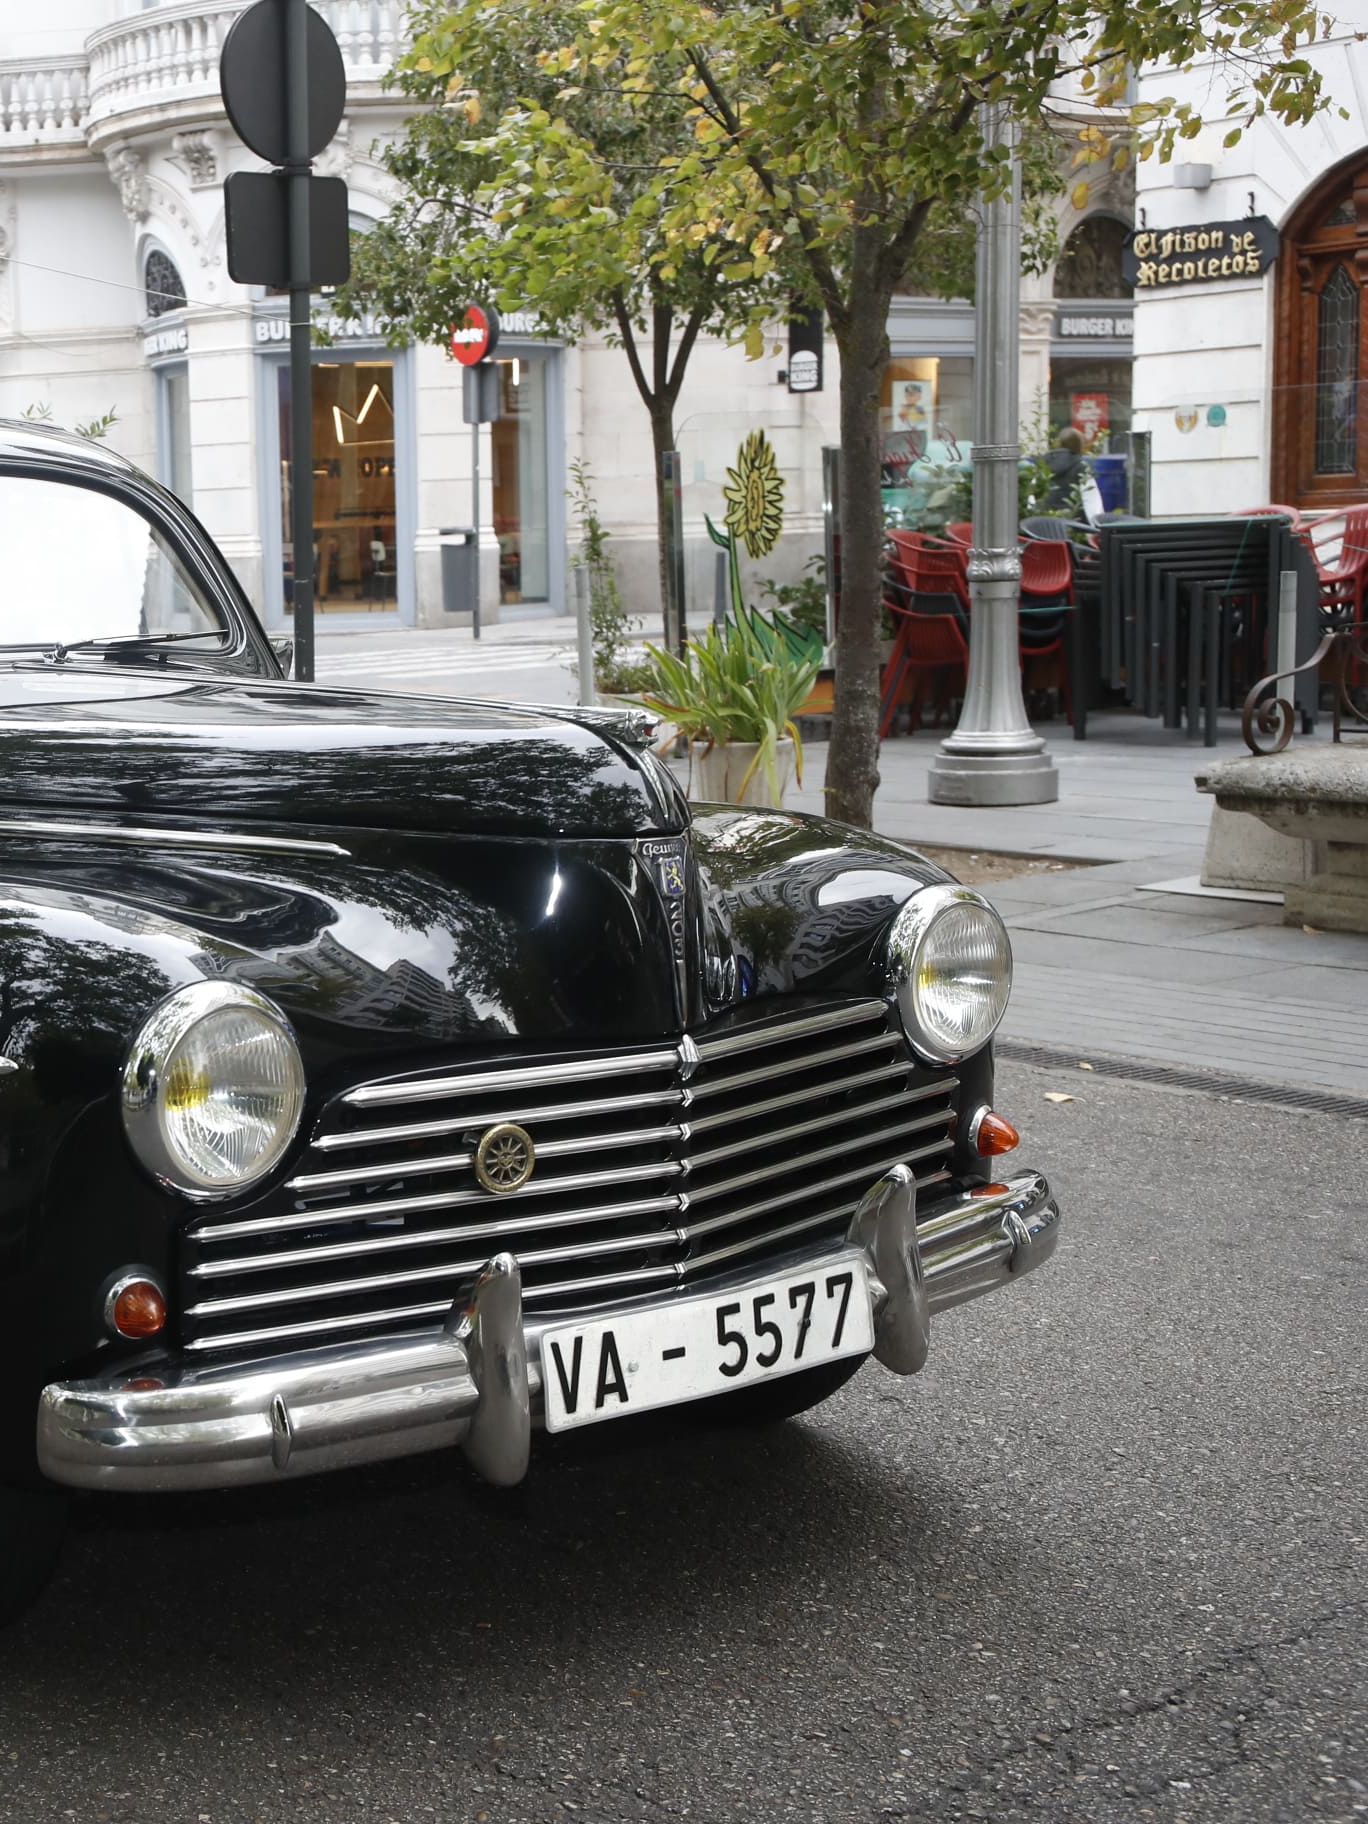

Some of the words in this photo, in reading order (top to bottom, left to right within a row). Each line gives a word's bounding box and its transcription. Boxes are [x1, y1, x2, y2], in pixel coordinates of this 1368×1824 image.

[1133, 231, 1158, 258] El
[1229, 230, 1258, 253] de
[1136, 250, 1263, 286] Recoletos
[255, 315, 344, 342] BUER
[1061, 317, 1113, 336] BURGER
[1115, 317, 1134, 336] KIN
[550, 1331, 629, 1414] VA
[716, 1271, 853, 1378] 5577
